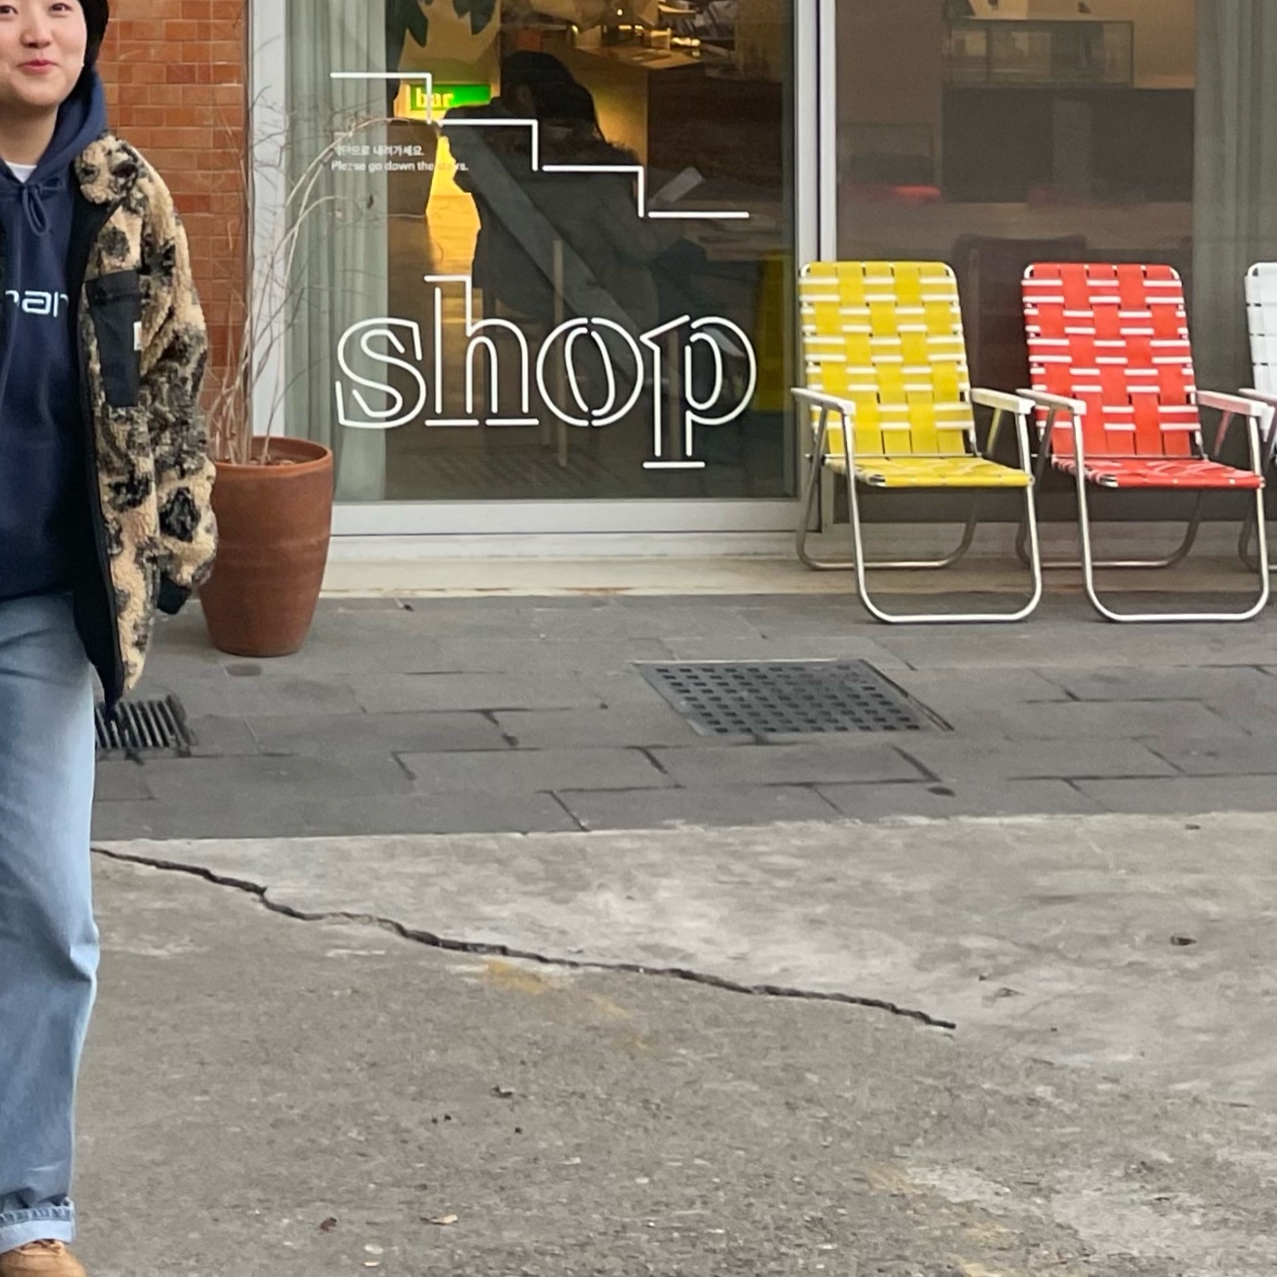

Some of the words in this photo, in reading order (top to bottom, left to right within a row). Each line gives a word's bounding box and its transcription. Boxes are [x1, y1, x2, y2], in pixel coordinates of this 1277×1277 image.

[416, 87, 454, 108] bar
[384, 160, 415, 172] down
[335, 275, 757, 469] shop
